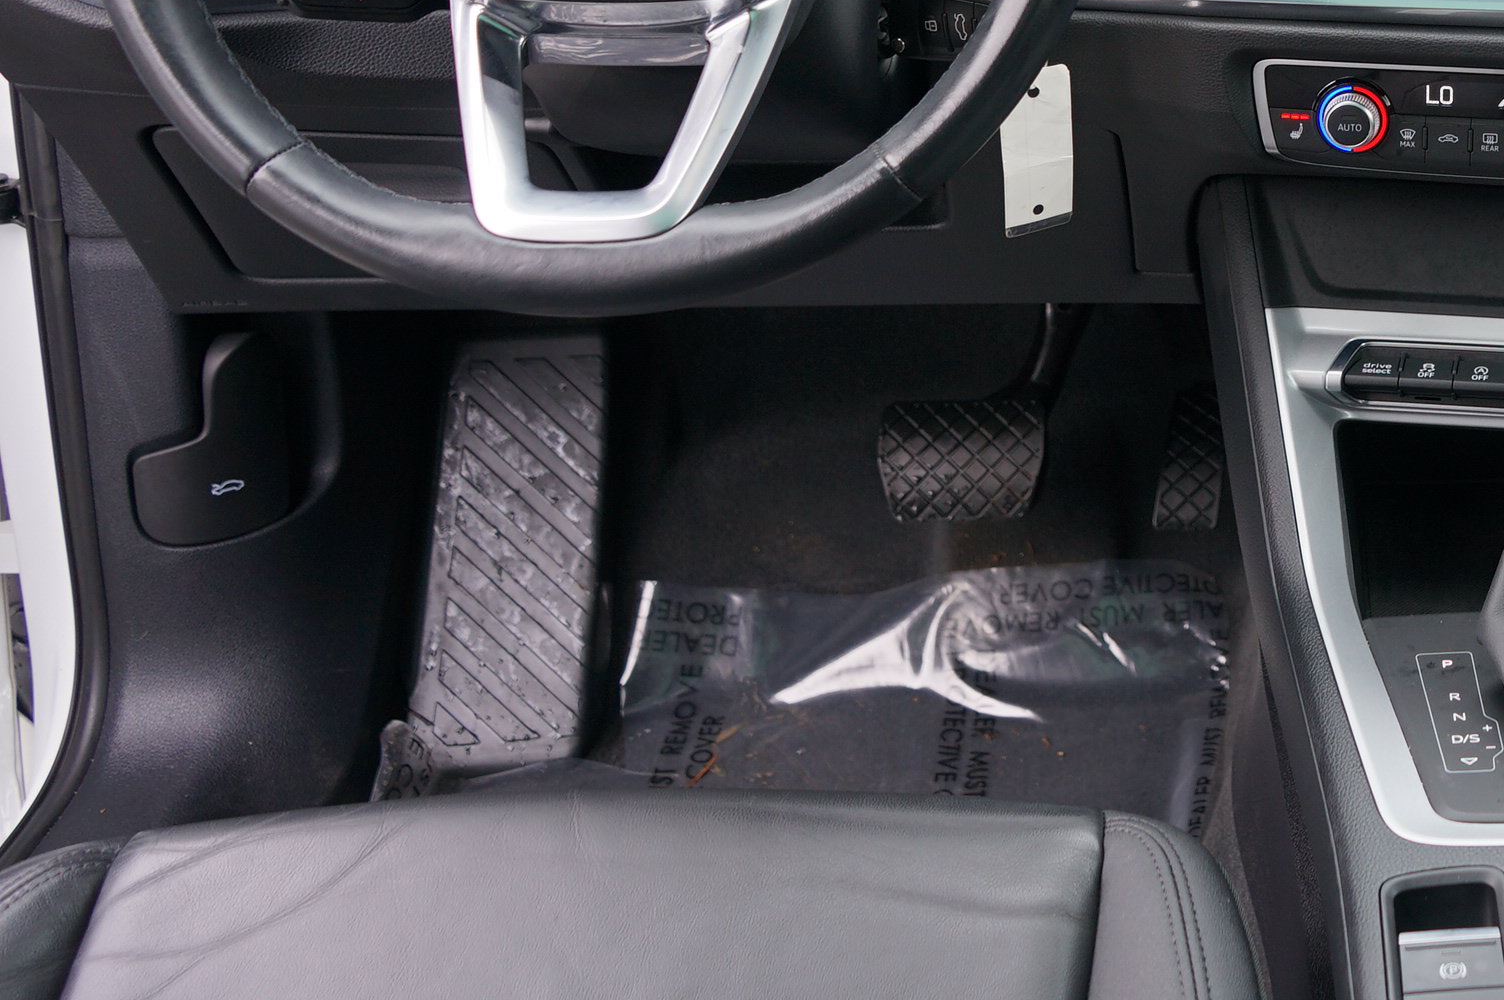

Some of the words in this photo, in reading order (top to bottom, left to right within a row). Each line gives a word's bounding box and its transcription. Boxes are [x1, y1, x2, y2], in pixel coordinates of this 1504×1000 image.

[1425, 84, 1455, 105] LO
[1337, 123, 1362, 132] AUTO
[1400, 140, 1416, 148] MAX
[1361, 367, 1392, 375] select
[1363, 362, 1392, 370] drive
[1000, 577, 1093, 605] COVER
[1103, 573, 1224, 597] OTECTIVE
[652, 599, 741, 627] PROTE
[1080, 603, 1145, 628] MUST
[1163, 601, 1225, 623] ALER
[648, 630, 739, 657] DEALE
[1441, 659, 1453, 668] P
[1449, 692, 1461, 701] R
[660, 663, 704, 757] REMOVE
[1453, 712, 1466, 722] N
[1451, 734, 1481, 744] D/S
